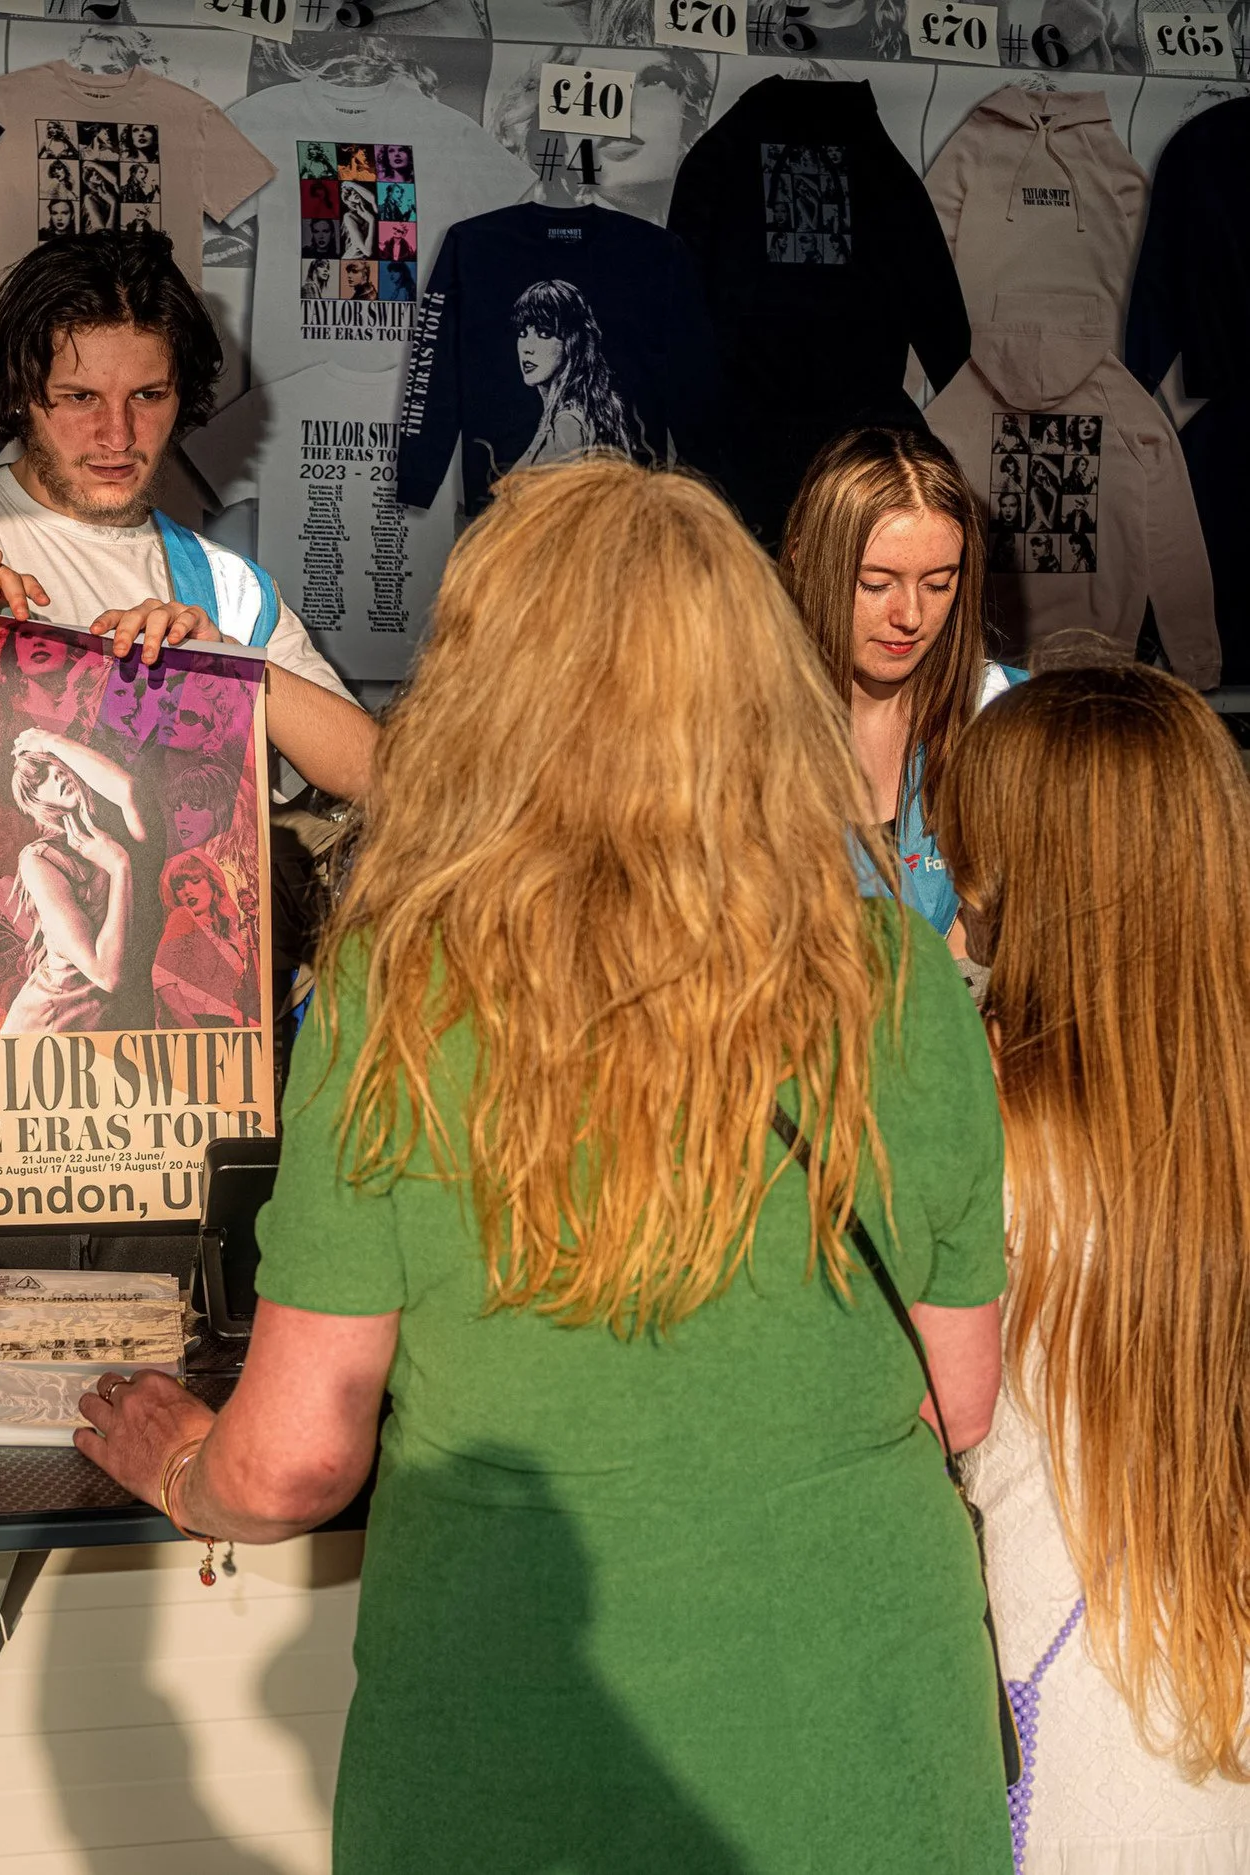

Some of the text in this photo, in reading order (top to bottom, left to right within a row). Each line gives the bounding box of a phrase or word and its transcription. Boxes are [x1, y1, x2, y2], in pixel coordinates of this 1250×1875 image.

[665, 0, 738, 39] £70
[749, 5, 818, 52] #5
[919, 12, 988, 50] £70
[1001, 23, 1069, 69] #6
[1155, 24, 1224, 57] £65
[548, 76, 625, 120] £40
[535, 138, 603, 187] #4
[1022, 188, 1070, 201] TAYLOR SWIFT
[300, 300, 417, 329] TAYLOR SWIFT
[301, 326, 417, 342] THE ERAS TOUR
[422, 291, 446, 341] TOUR
[413, 346, 435, 395] ERAS
[300, 419, 398, 448] TAYLOR SWI
[405, 398, 425, 437] THE
[299, 464, 346, 480] 2023
[301, 446, 397, 462] THE ERAS TO
[114, 1030, 263, 1110] SWIFT
[15, 1113, 132, 1153] ERAS
[143, 1109, 263, 1149] TOUR
[6, 1165, 48, 1176] August/
[51, 1164, 62, 1173] 17
[64, 1162, 107, 1175] August/
[109, 1163, 122, 1172] 19
[124, 1161, 167, 1174] August/
[169, 1161, 183, 1170] 20
[21, 1150, 165, 1165] 21 June/ 22 June/ 23 June/
[162, 1171, 204, 1211] U
